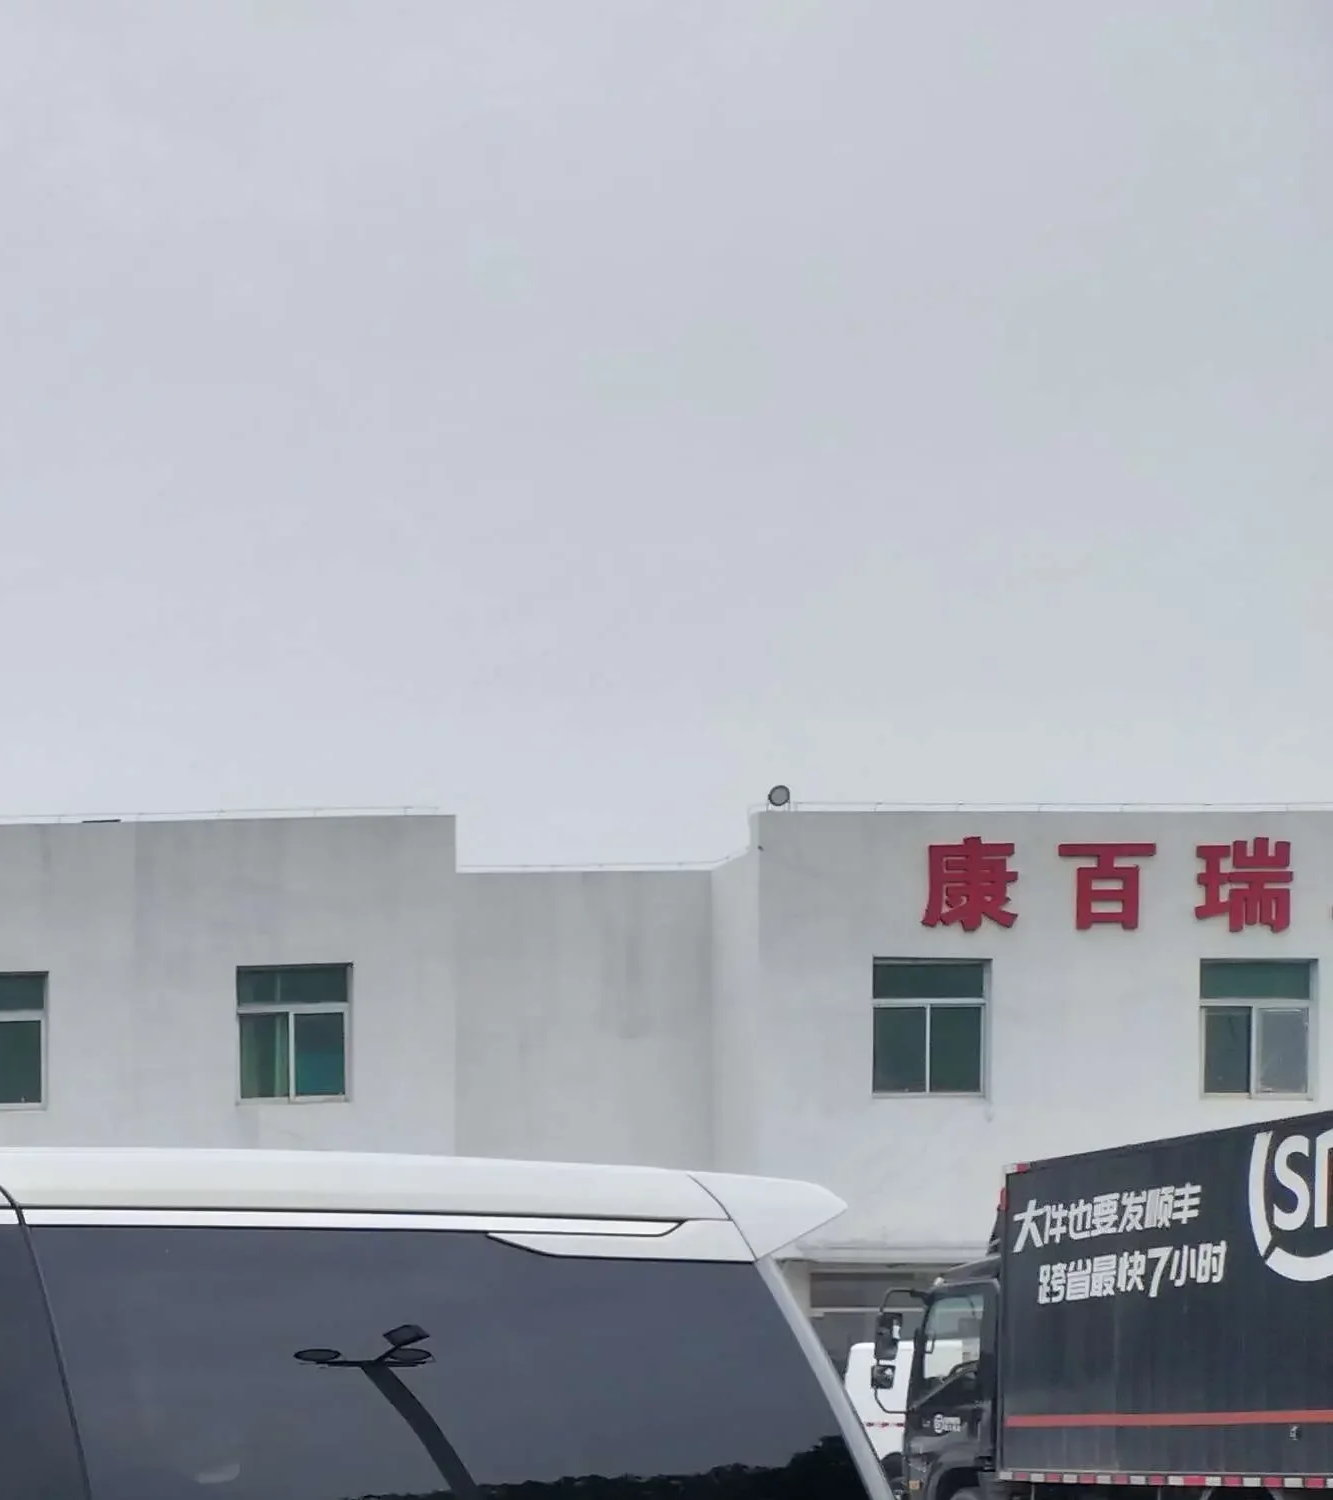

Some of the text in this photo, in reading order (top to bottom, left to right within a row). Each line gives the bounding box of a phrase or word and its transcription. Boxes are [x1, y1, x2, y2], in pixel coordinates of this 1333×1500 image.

[920, 836, 1333, 933] 康百瑞
[1012, 1182, 1202, 1254] 大件也要发顺丰
[1037, 1240, 1228, 1305] 跨省最快7小时
